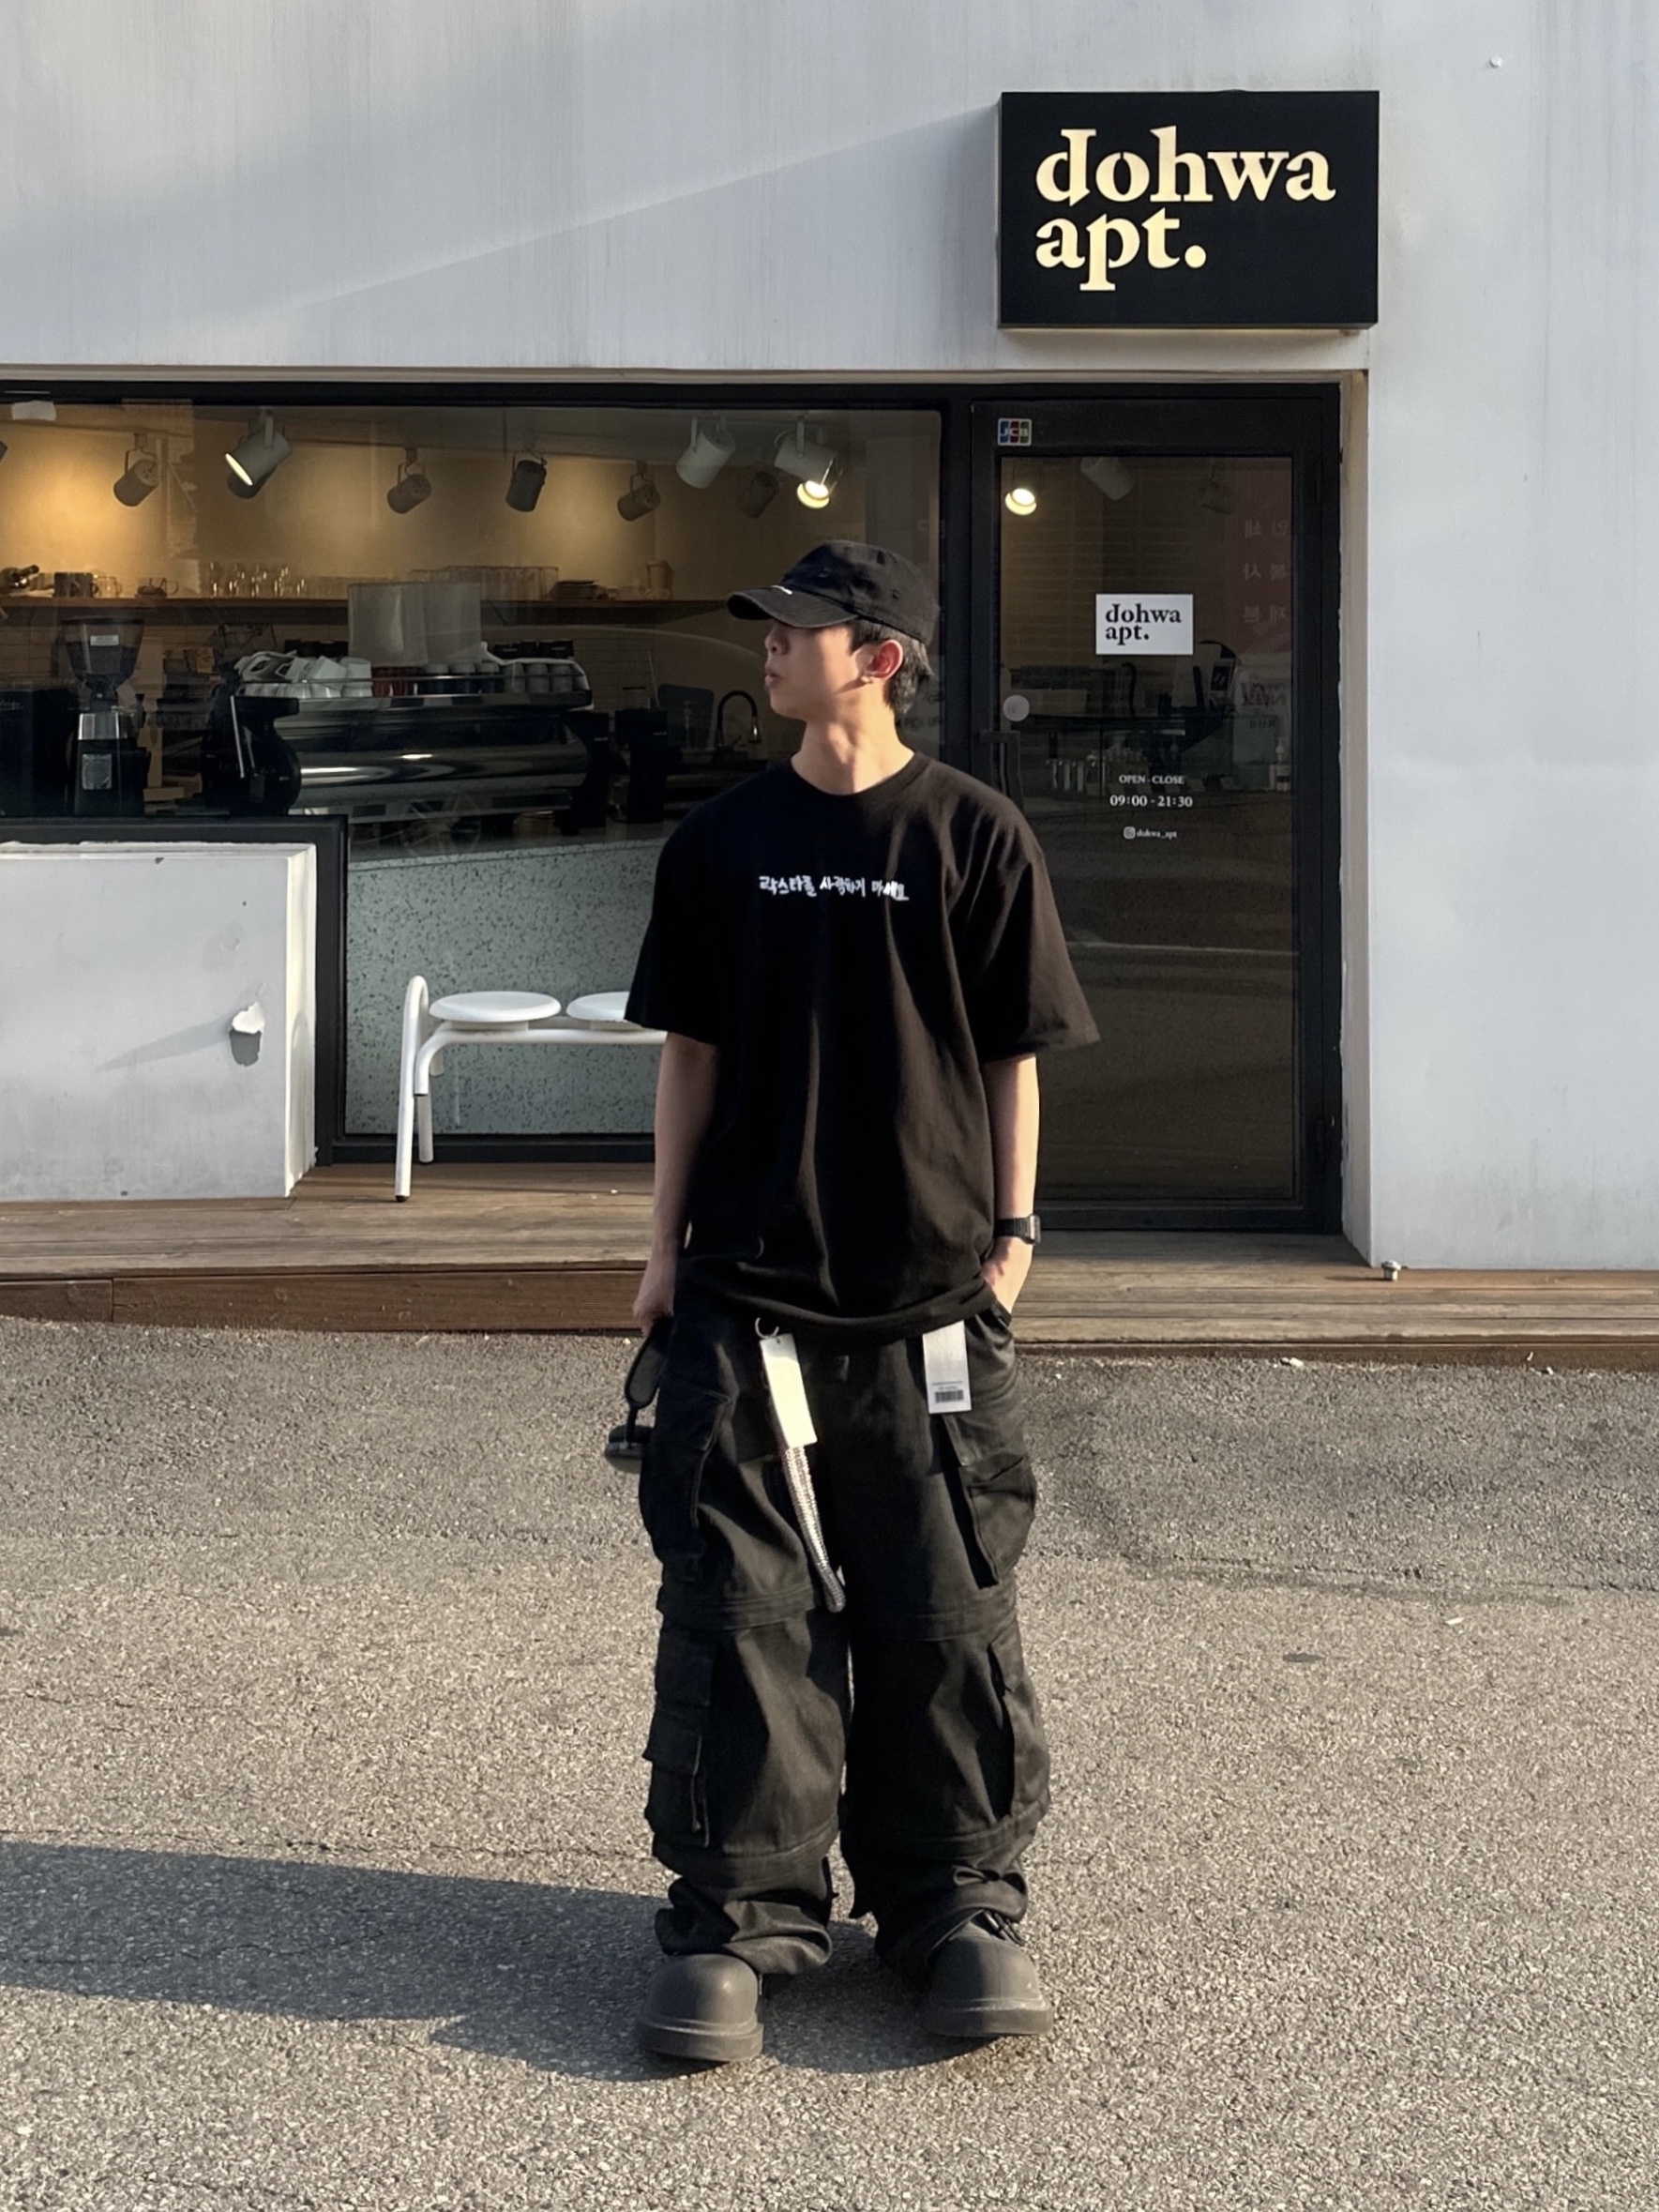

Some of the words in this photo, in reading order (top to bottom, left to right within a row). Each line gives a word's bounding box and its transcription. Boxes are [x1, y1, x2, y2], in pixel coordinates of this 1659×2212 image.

[1035, 125, 1336, 207] dohwa
[1035, 207, 1207, 291] apt.
[1000, 427, 1030, 437] JCB
[1105, 602, 1183, 624] dohwa
[1105, 624, 1150, 646] apt.
[1119, 775, 1145, 783] OPEN
[1152, 775, 1185, 784] CLOSE
[1109, 795, 1148, 806] 09:00
[1157, 795, 1194, 808] 21:30
[759, 875, 817, 897] 락스타를
[819, 876, 866, 897] 사랑하기
[871, 880, 910, 901] 마세요
